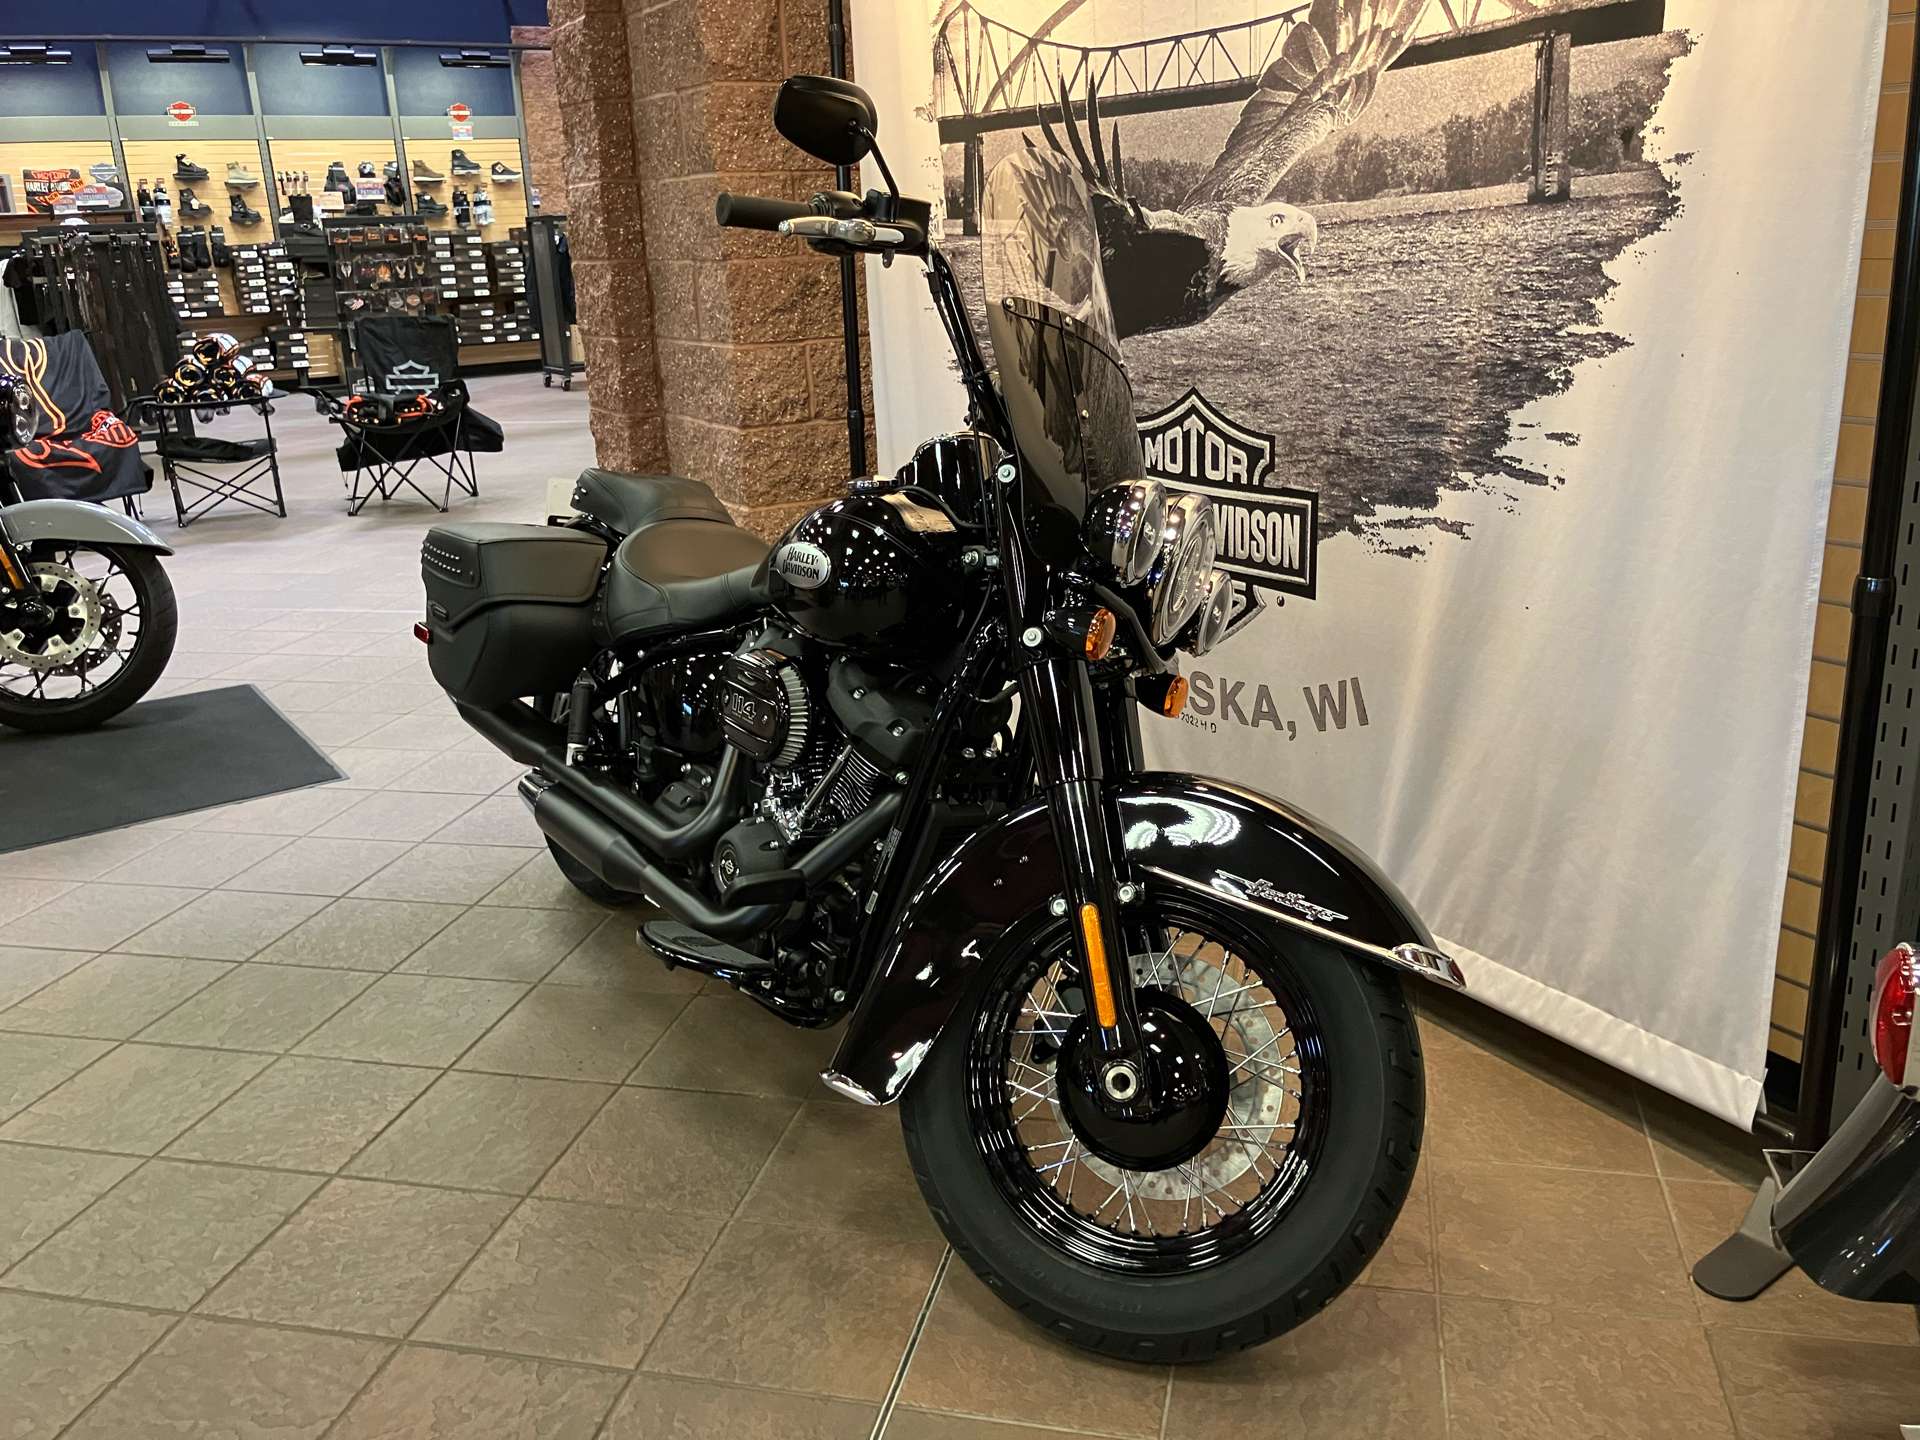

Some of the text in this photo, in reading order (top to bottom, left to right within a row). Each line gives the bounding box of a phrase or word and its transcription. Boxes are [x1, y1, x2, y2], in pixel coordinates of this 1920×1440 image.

[70, 179, 84, 190] NEW
[47, 193, 59, 203] NEW
[1144, 413, 1248, 485] MOTOR
[1212, 502, 1301, 570] VIDSON
[782, 559, 820, 581] DAVIDSON
[731, 692, 757, 720] 114
[1184, 670, 1369, 742] SKA, WI
[1181, 711, 1199, 728] 2022
